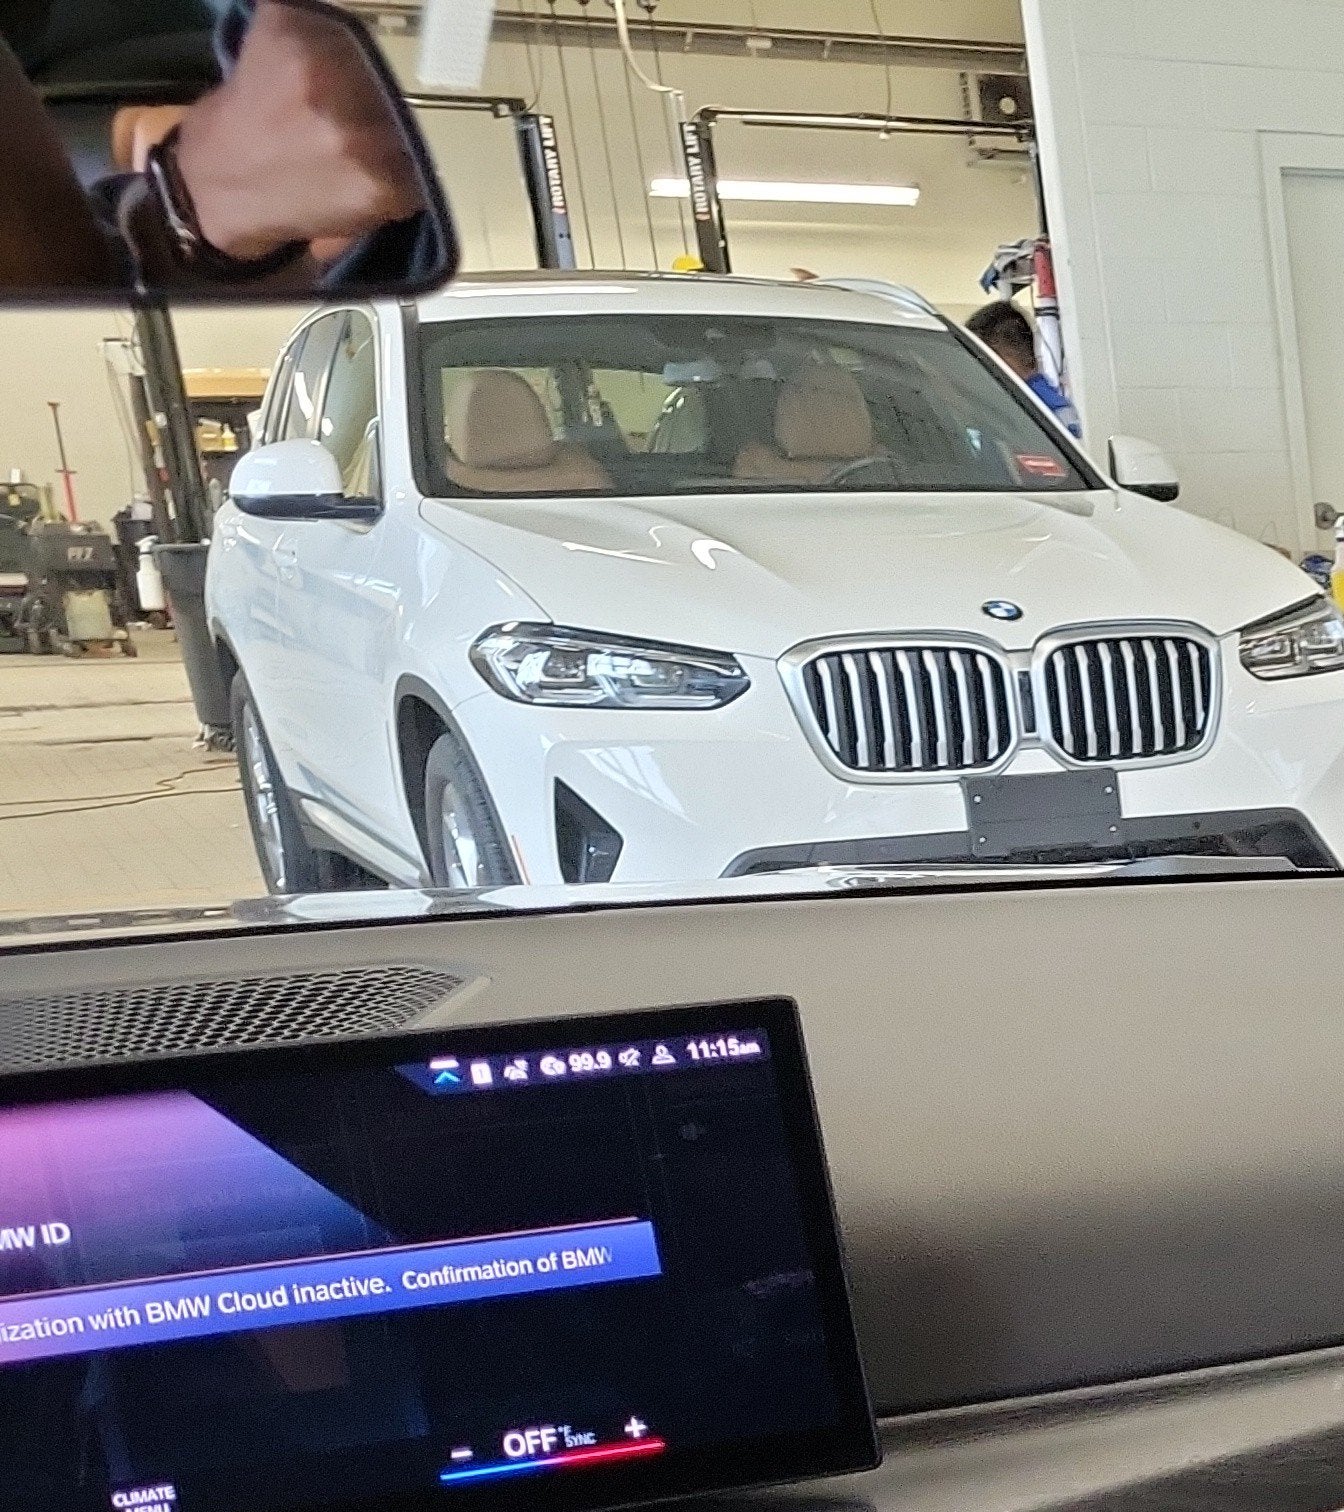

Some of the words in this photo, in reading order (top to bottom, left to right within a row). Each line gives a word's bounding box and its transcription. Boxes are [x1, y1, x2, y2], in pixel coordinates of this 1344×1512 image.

[688, 155, 709, 214] ROTARY
[568, 1051, 612, 1073] 99.9
[40, 1222, 71, 1245] ID
[88, 1306, 140, 1331] with
[146, 1295, 211, 1323] BMW
[218, 1284, 288, 1314] Cloud
[292, 1274, 391, 1305] inactive.
[402, 1258, 533, 1290] Confirmation
[537, 1256, 558, 1273] of
[503, 1427, 558, 1457] OFF
[564, 1432, 597, 1447] SYNC
[112, 1485, 176, 1507] CLIMATE
